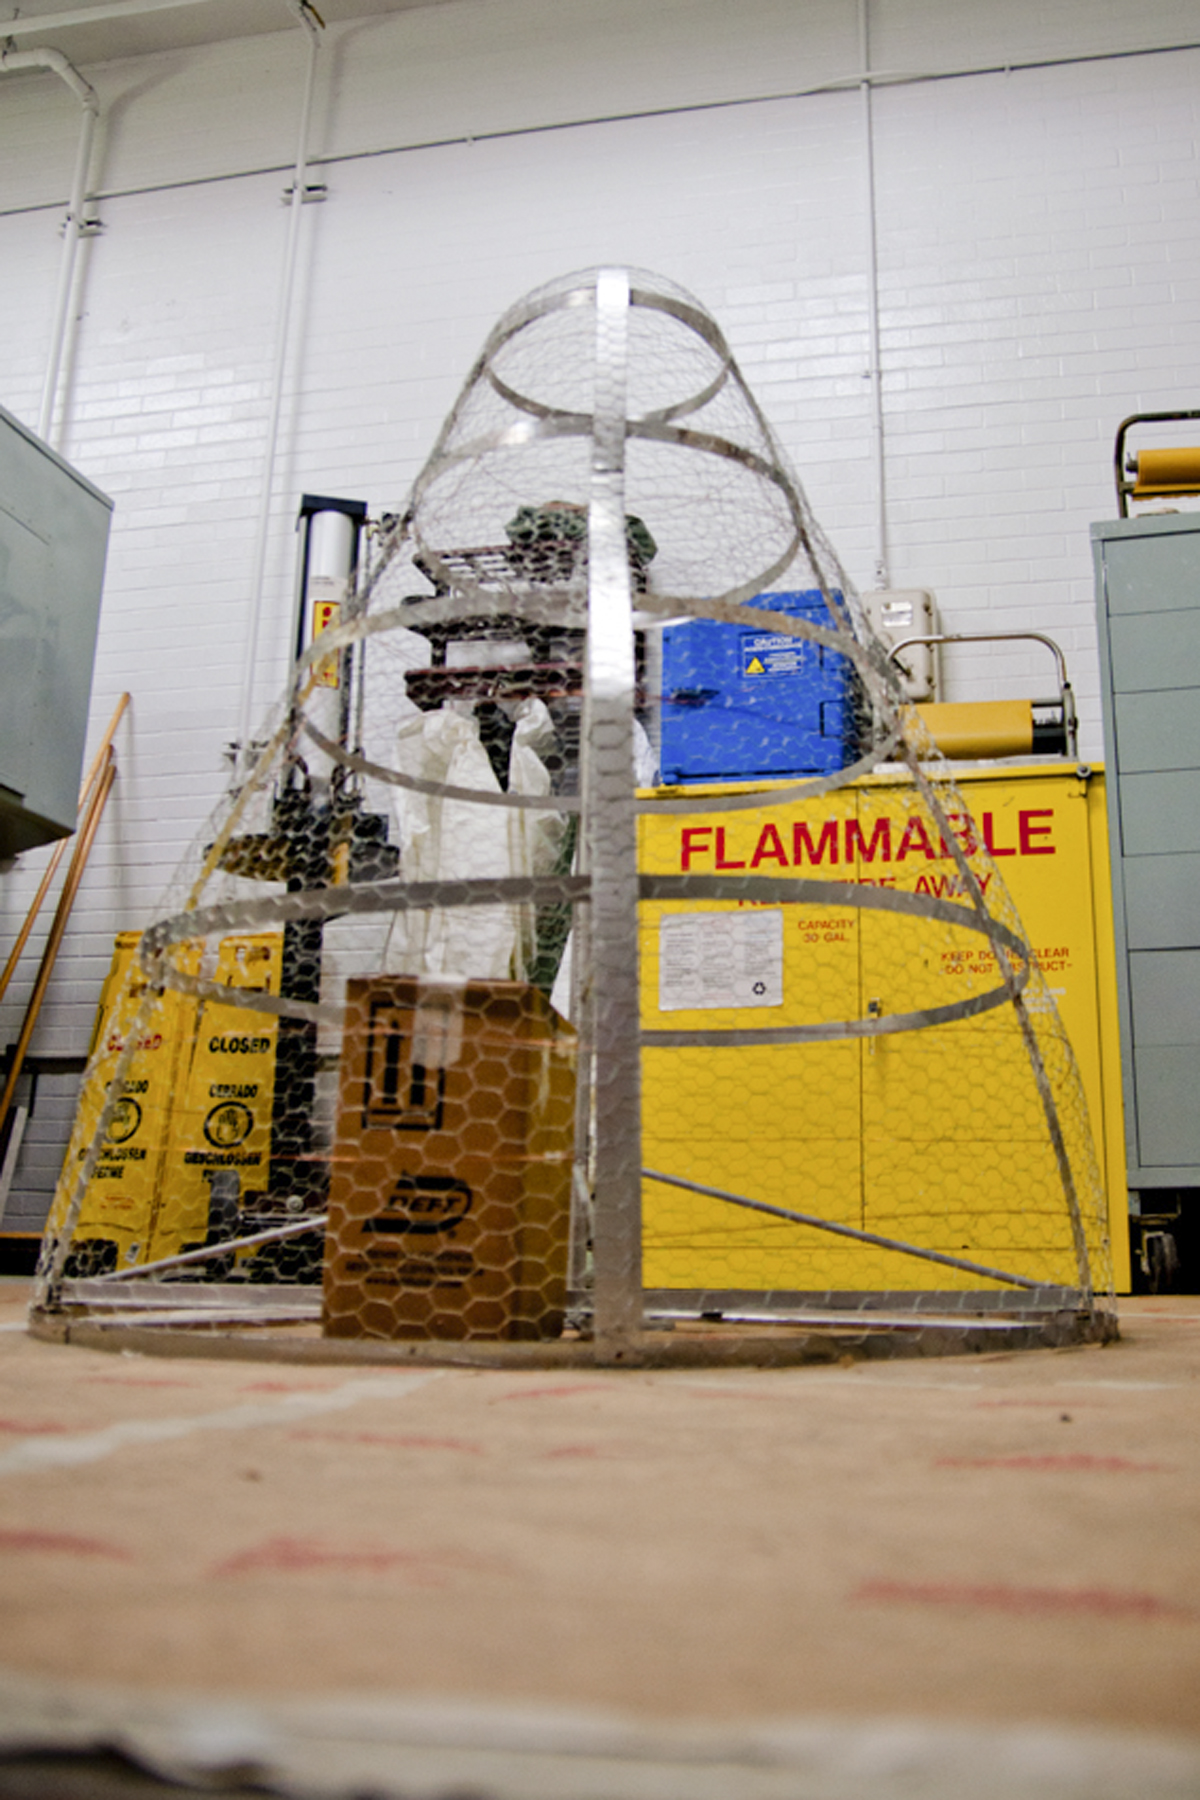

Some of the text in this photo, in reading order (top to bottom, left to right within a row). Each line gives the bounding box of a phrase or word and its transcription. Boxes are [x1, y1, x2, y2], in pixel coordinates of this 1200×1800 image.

[680, 809, 1056, 871] FLAMMABLE
[797, 918, 855, 931] CAPACITY
[940, 950, 973, 963] KEEP
[968, 962, 993, 974] NOT
[107, 1034, 162, 1051] CLSED
[208, 1036, 271, 1053] CLOSED
